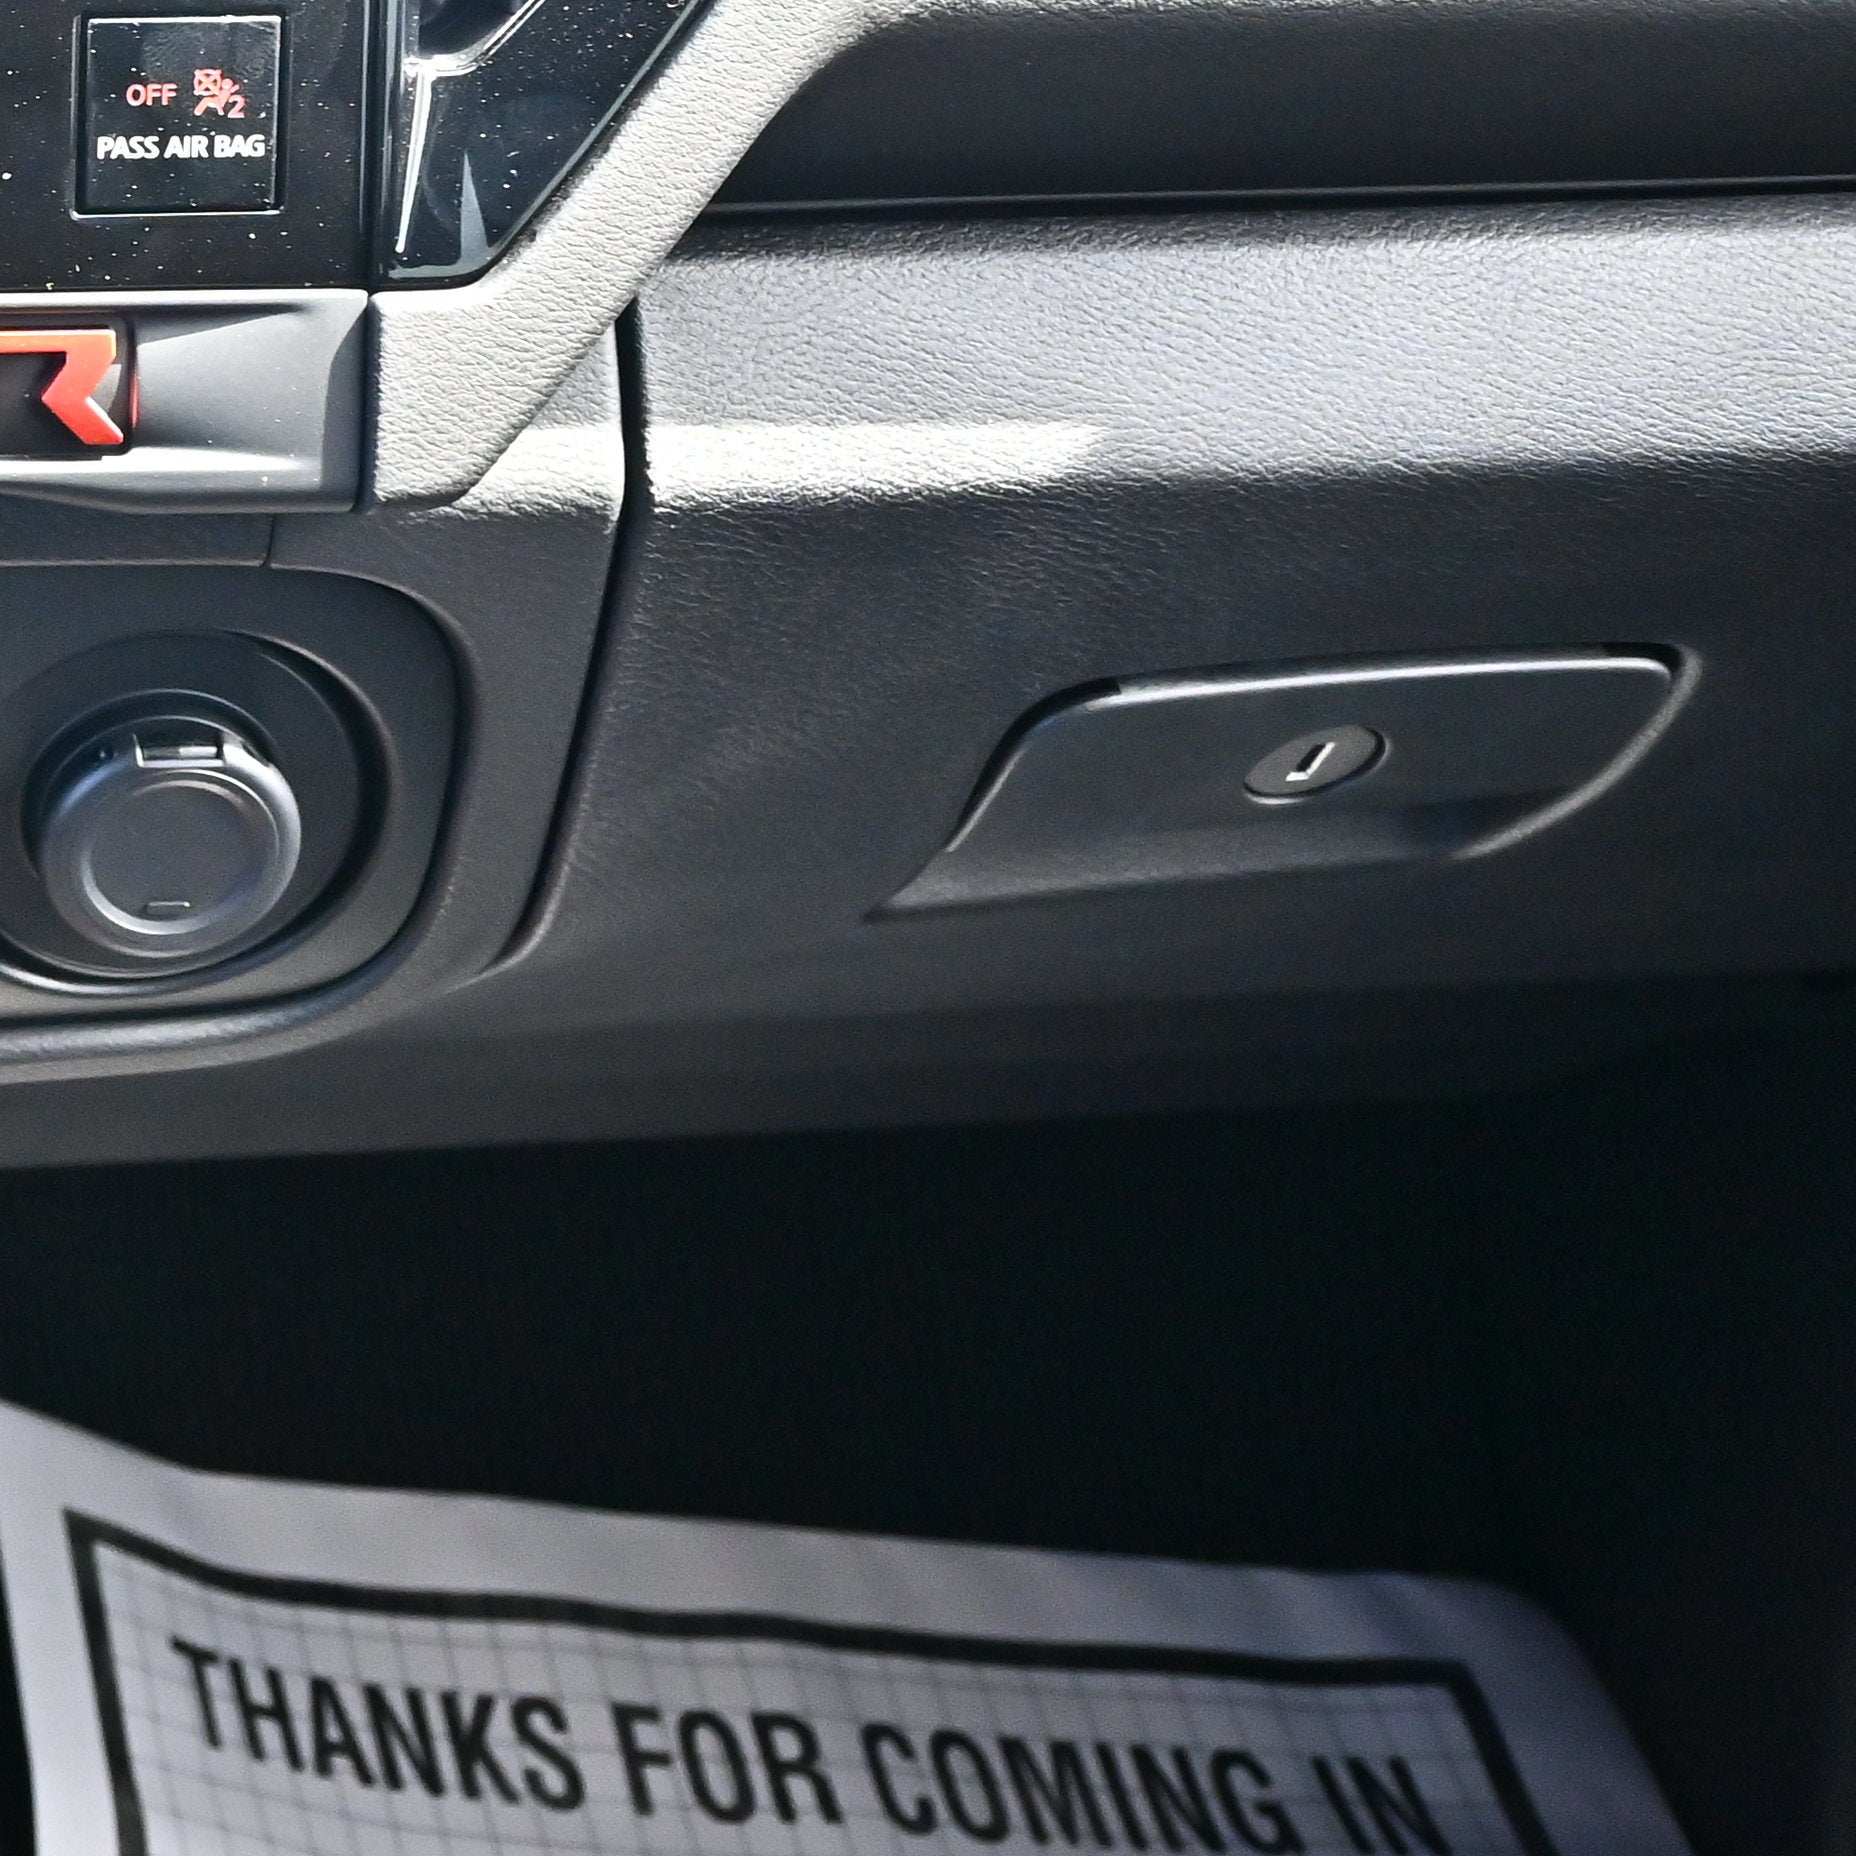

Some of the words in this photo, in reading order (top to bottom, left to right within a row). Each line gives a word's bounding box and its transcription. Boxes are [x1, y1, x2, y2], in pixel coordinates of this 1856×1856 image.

[126, 83, 178, 106] OFF
[96, 135, 160, 160] PASS
[164, 135, 209, 159] AIR
[214, 134, 266, 158] BAG
[169, 1632, 586, 1811] THANKS
[609, 1700, 843, 1824] FOR
[855, 1721, 1308, 1854] COMING
[1308, 1752, 1454, 1856] IN
